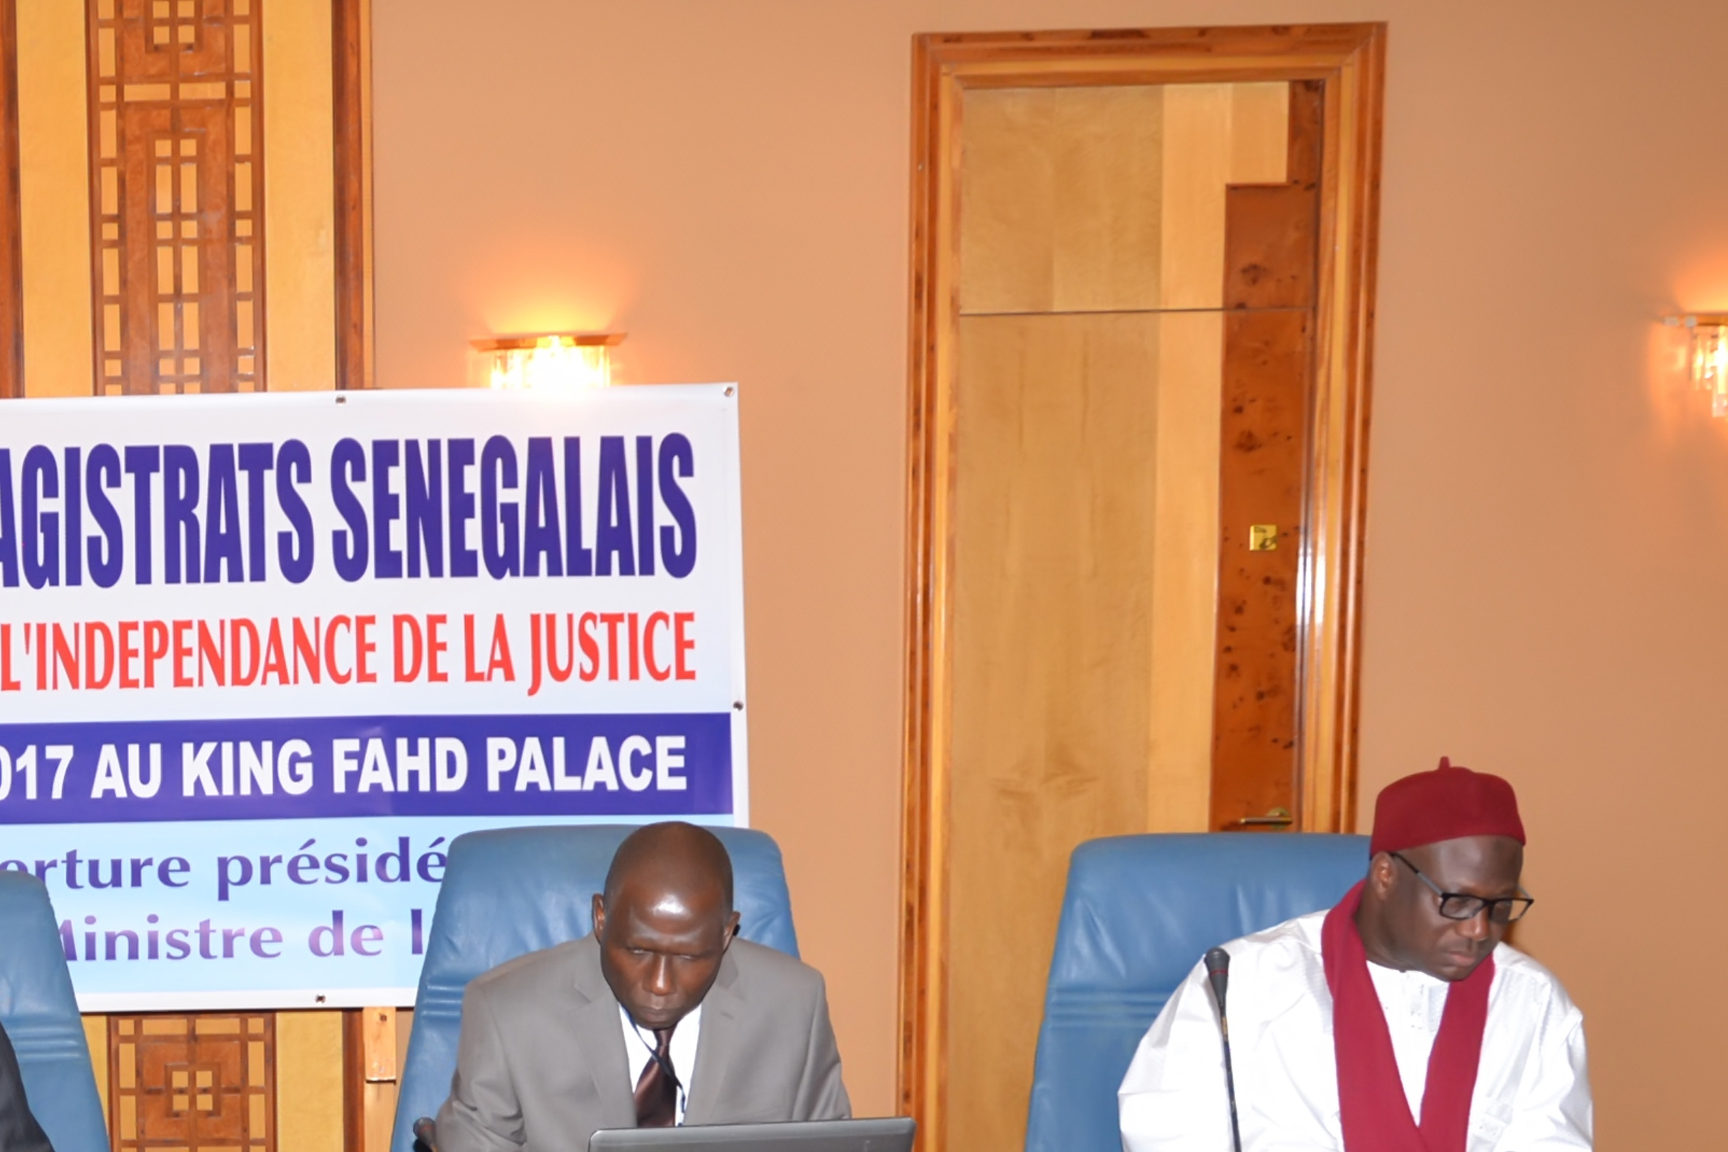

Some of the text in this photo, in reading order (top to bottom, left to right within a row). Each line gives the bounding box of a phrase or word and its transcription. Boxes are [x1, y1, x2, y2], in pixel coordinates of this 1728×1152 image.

[330, 432, 697, 582] SENEGALAIS
[0, 614, 377, 692] L'INDEPENDANCE
[393, 613, 449, 683] DE
[464, 613, 515, 682] LA
[528, 611, 696, 697] JUSTICE
[90, 742, 163, 799] AU
[181, 738, 314, 798] KING
[332, 736, 469, 794] FAHD
[486, 734, 688, 792] PALACE
[217, 835, 448, 901] présidé
[307, 909, 384, 956] de
[410, 908, 424, 955] l
